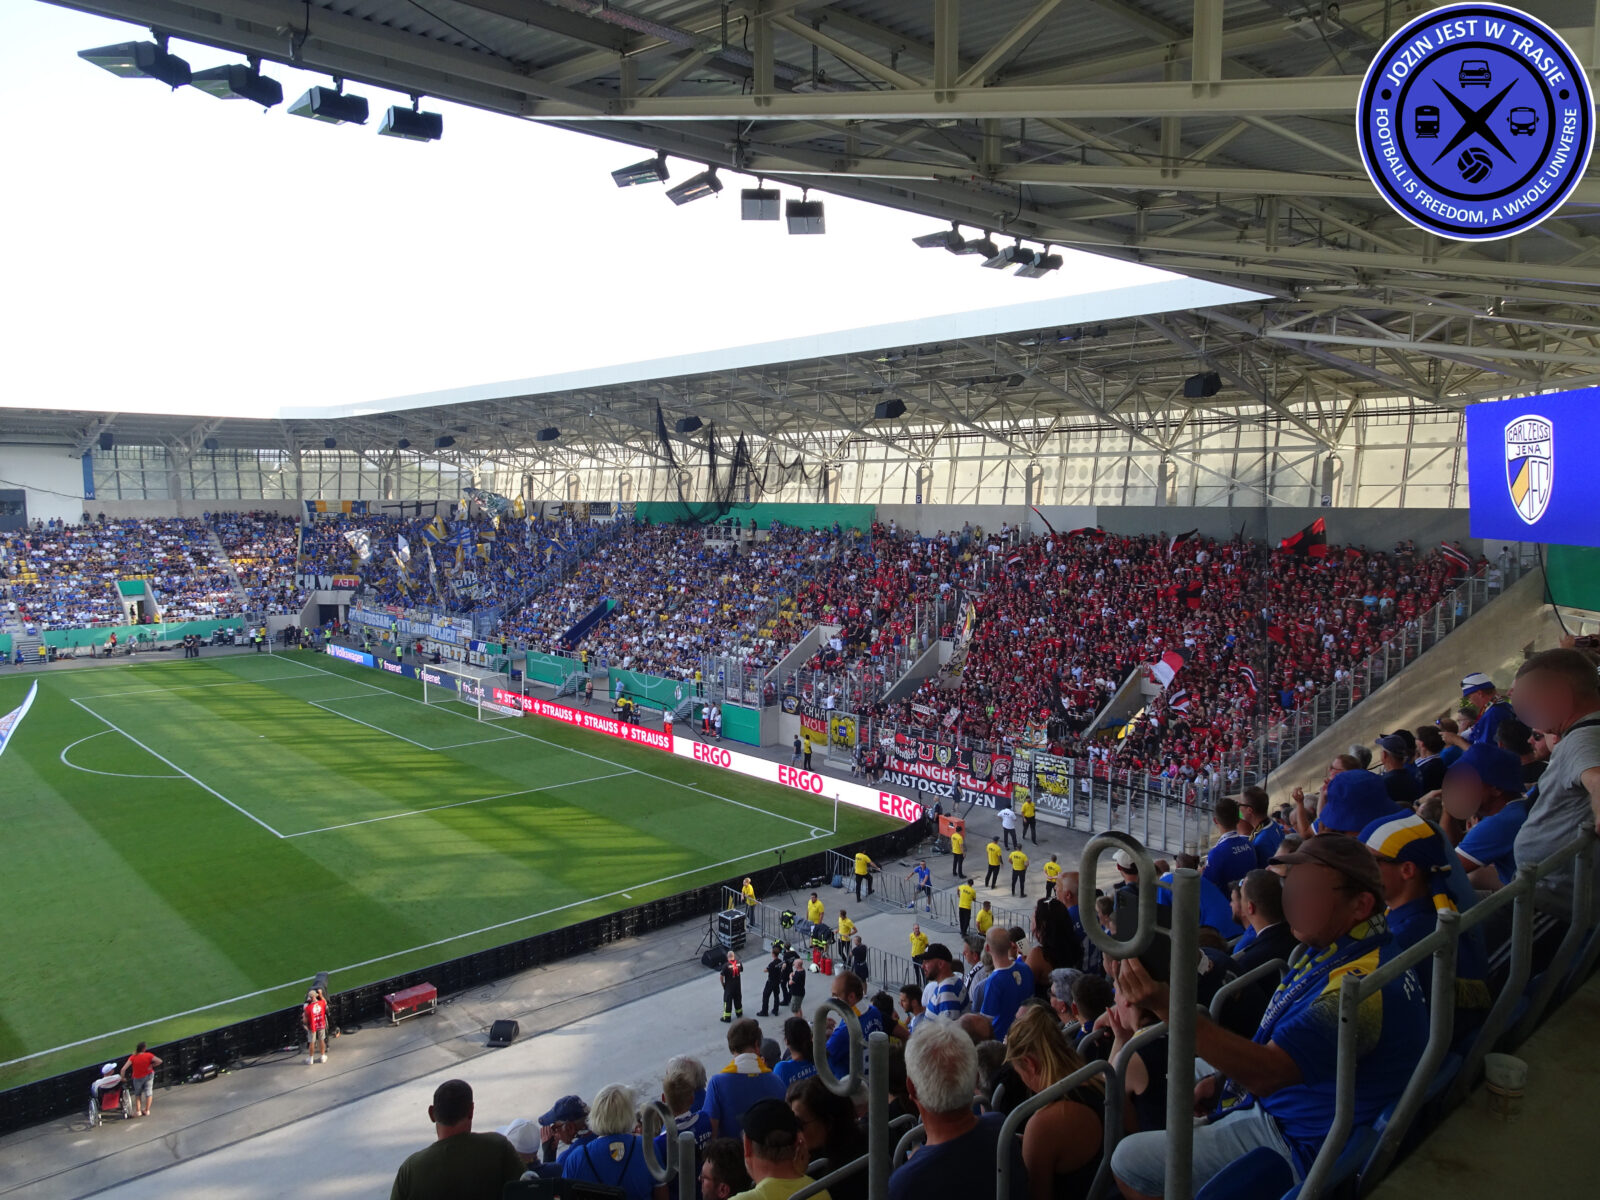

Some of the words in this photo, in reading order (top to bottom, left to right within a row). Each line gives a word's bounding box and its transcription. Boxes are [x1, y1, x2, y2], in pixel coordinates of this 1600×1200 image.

[1515, 444, 1542, 456] JENA
[541, 704, 573, 721] STRAUSS
[583, 714, 619, 734] STRAUSS
[631, 728, 670, 749] STRAUSS
[693, 741, 732, 768] ERGO
[778, 764, 824, 794] ERGO
[878, 791, 923, 825] ERGO
